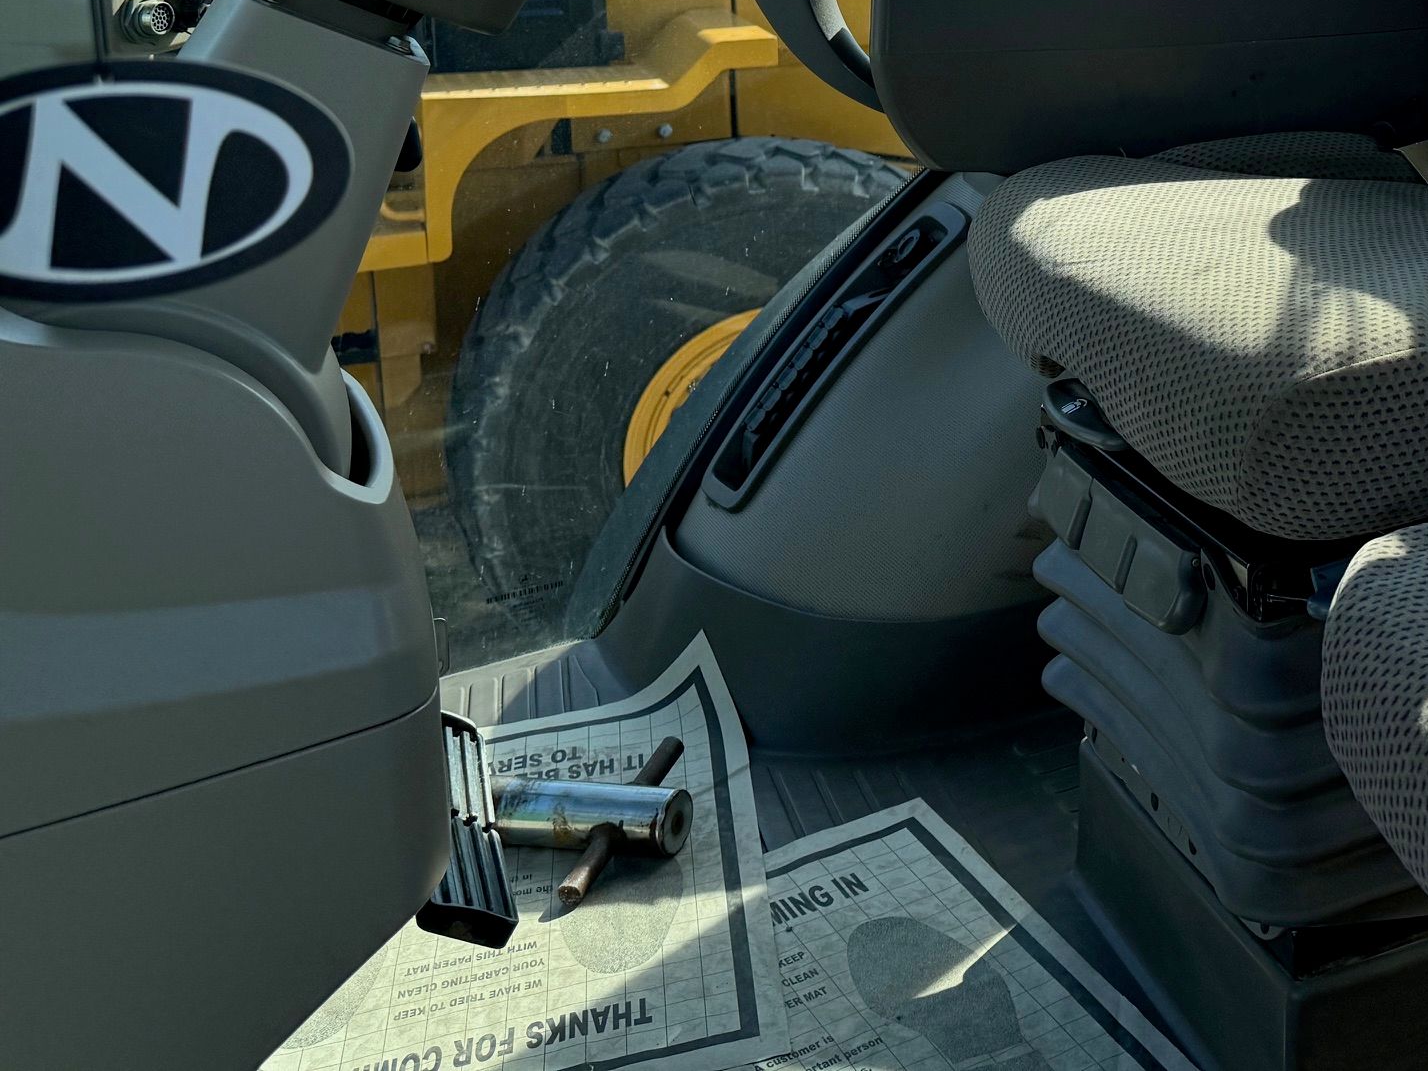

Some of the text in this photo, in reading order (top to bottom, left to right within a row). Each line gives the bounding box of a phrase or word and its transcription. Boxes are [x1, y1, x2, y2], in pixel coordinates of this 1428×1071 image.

[551, 746, 582, 764] TO
[623, 753, 645, 772] IT
[568, 758, 615, 779] HAS
[831, 872, 870, 899] IN
[405, 941, 537, 977] WITH THIS PAPER MAT
[778, 951, 805, 968] KEEP
[398, 957, 545, 999] YOUR CARPETING CLEAN
[782, 968, 819, 987] CLEAN
[393, 979, 543, 1022] WE HAVE TRIED TO KEEP
[804, 986, 828, 1003] MAT
[526, 998, 653, 1049] THANKS
[453, 1027, 515, 1068] FOR
[766, 1040, 820, 1068] customer
[821, 1034, 835, 1044] is
[843, 1036, 884, 1060] person
